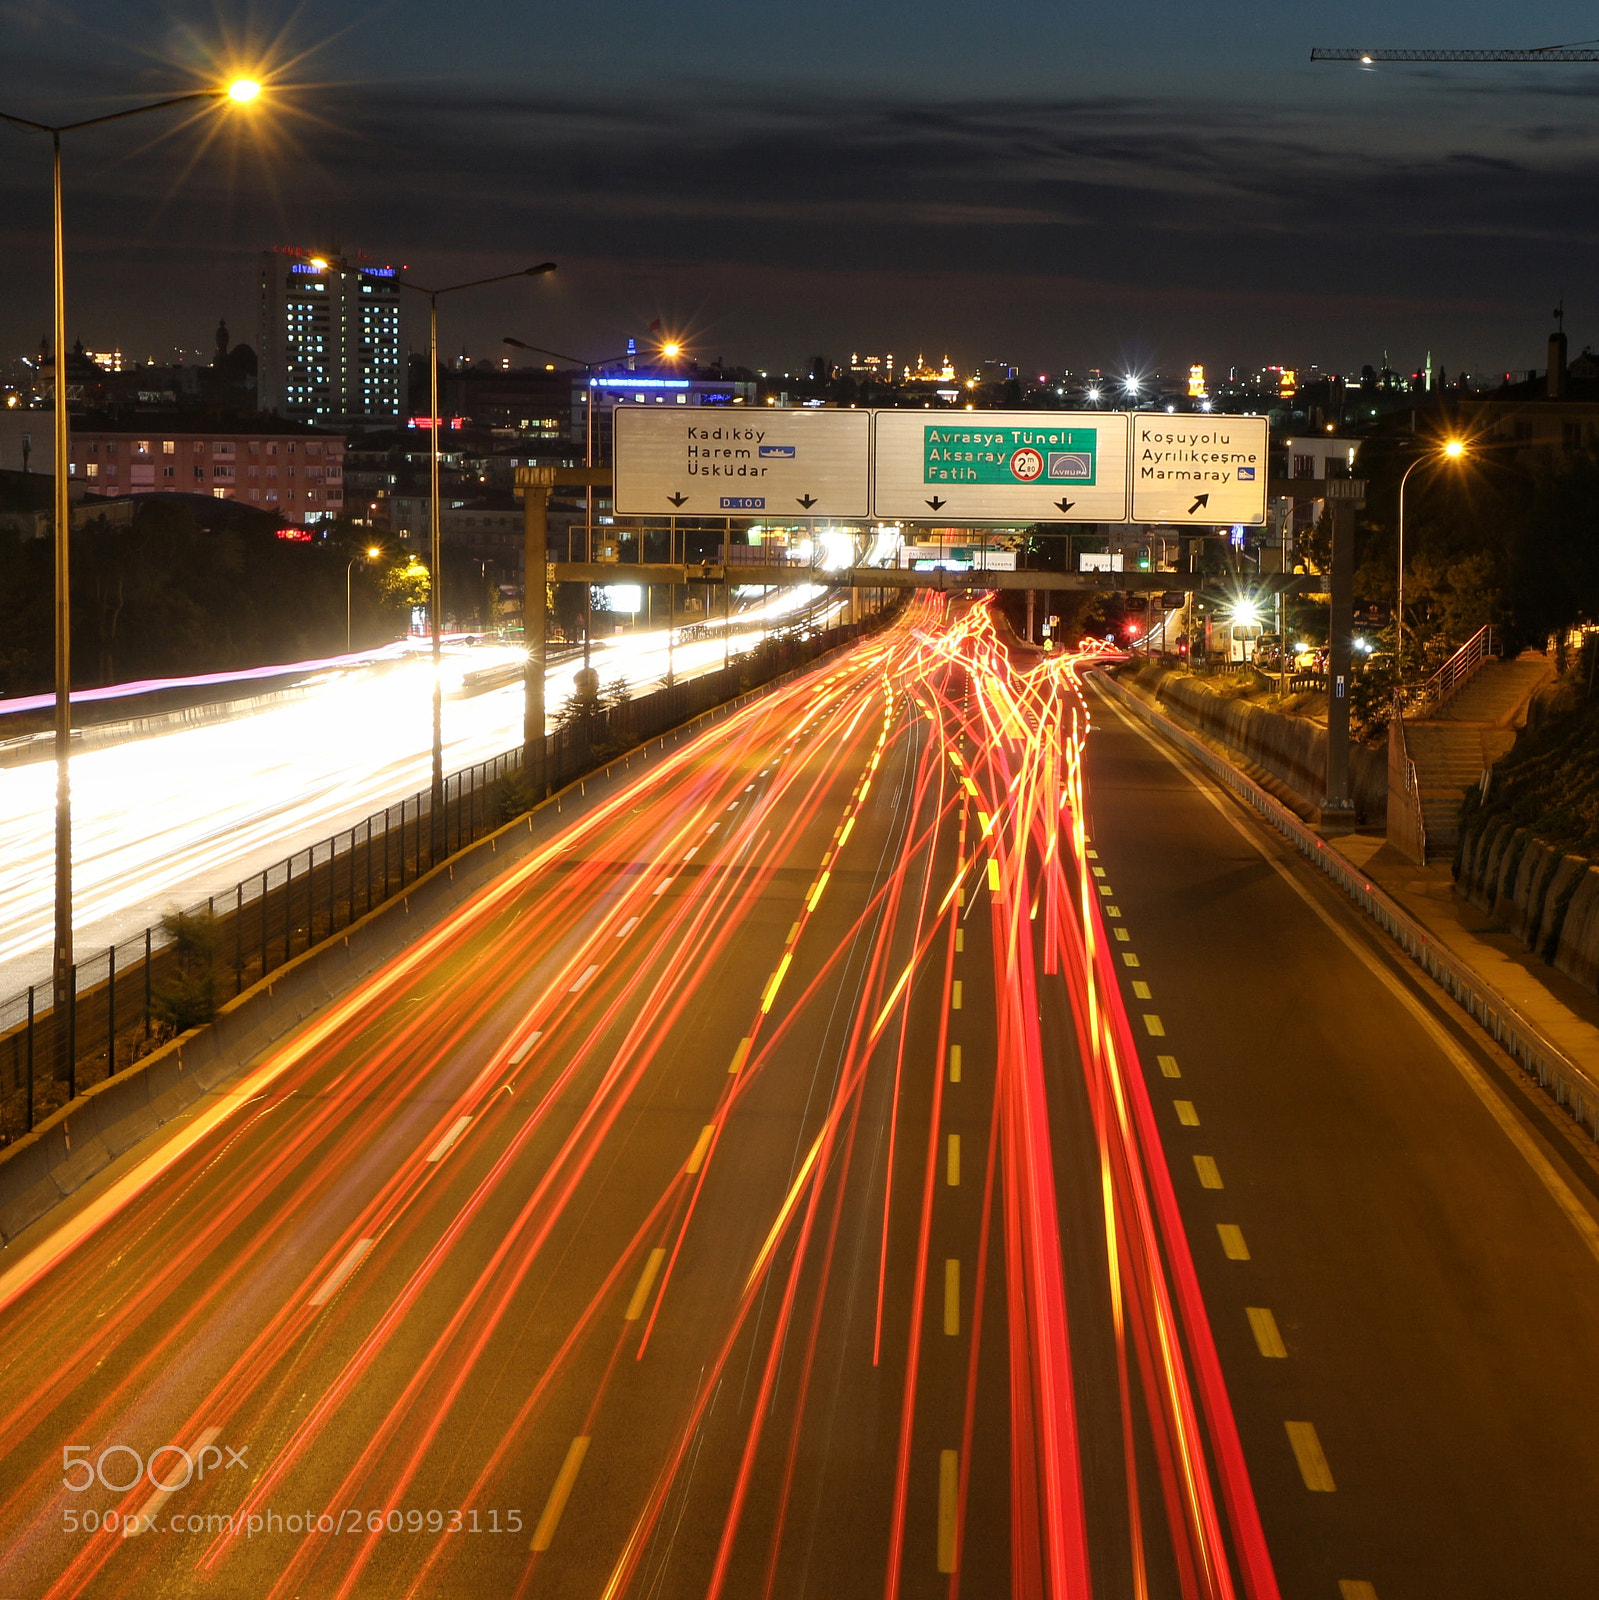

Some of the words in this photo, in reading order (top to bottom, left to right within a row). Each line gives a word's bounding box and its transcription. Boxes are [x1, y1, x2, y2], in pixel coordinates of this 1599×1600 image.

[688, 427, 765, 443] Kadıköy
[929, 430, 1004, 447] Avrasya
[1011, 431, 1073, 444] Tüneli
[1142, 430, 1230, 446] Koşuyolu
[688, 445, 751, 458] Harem
[929, 448, 1006, 465] Aksaray
[1142, 449, 1257, 464] Ayrılıkçeşme
[688, 460, 768, 476] Üsküdar
[928, 466, 977, 479] Fatih
[1018, 457, 1026, 472] 2
[1141, 467, 1231, 484] Marmaray
[723, 498, 762, 507] D.100
